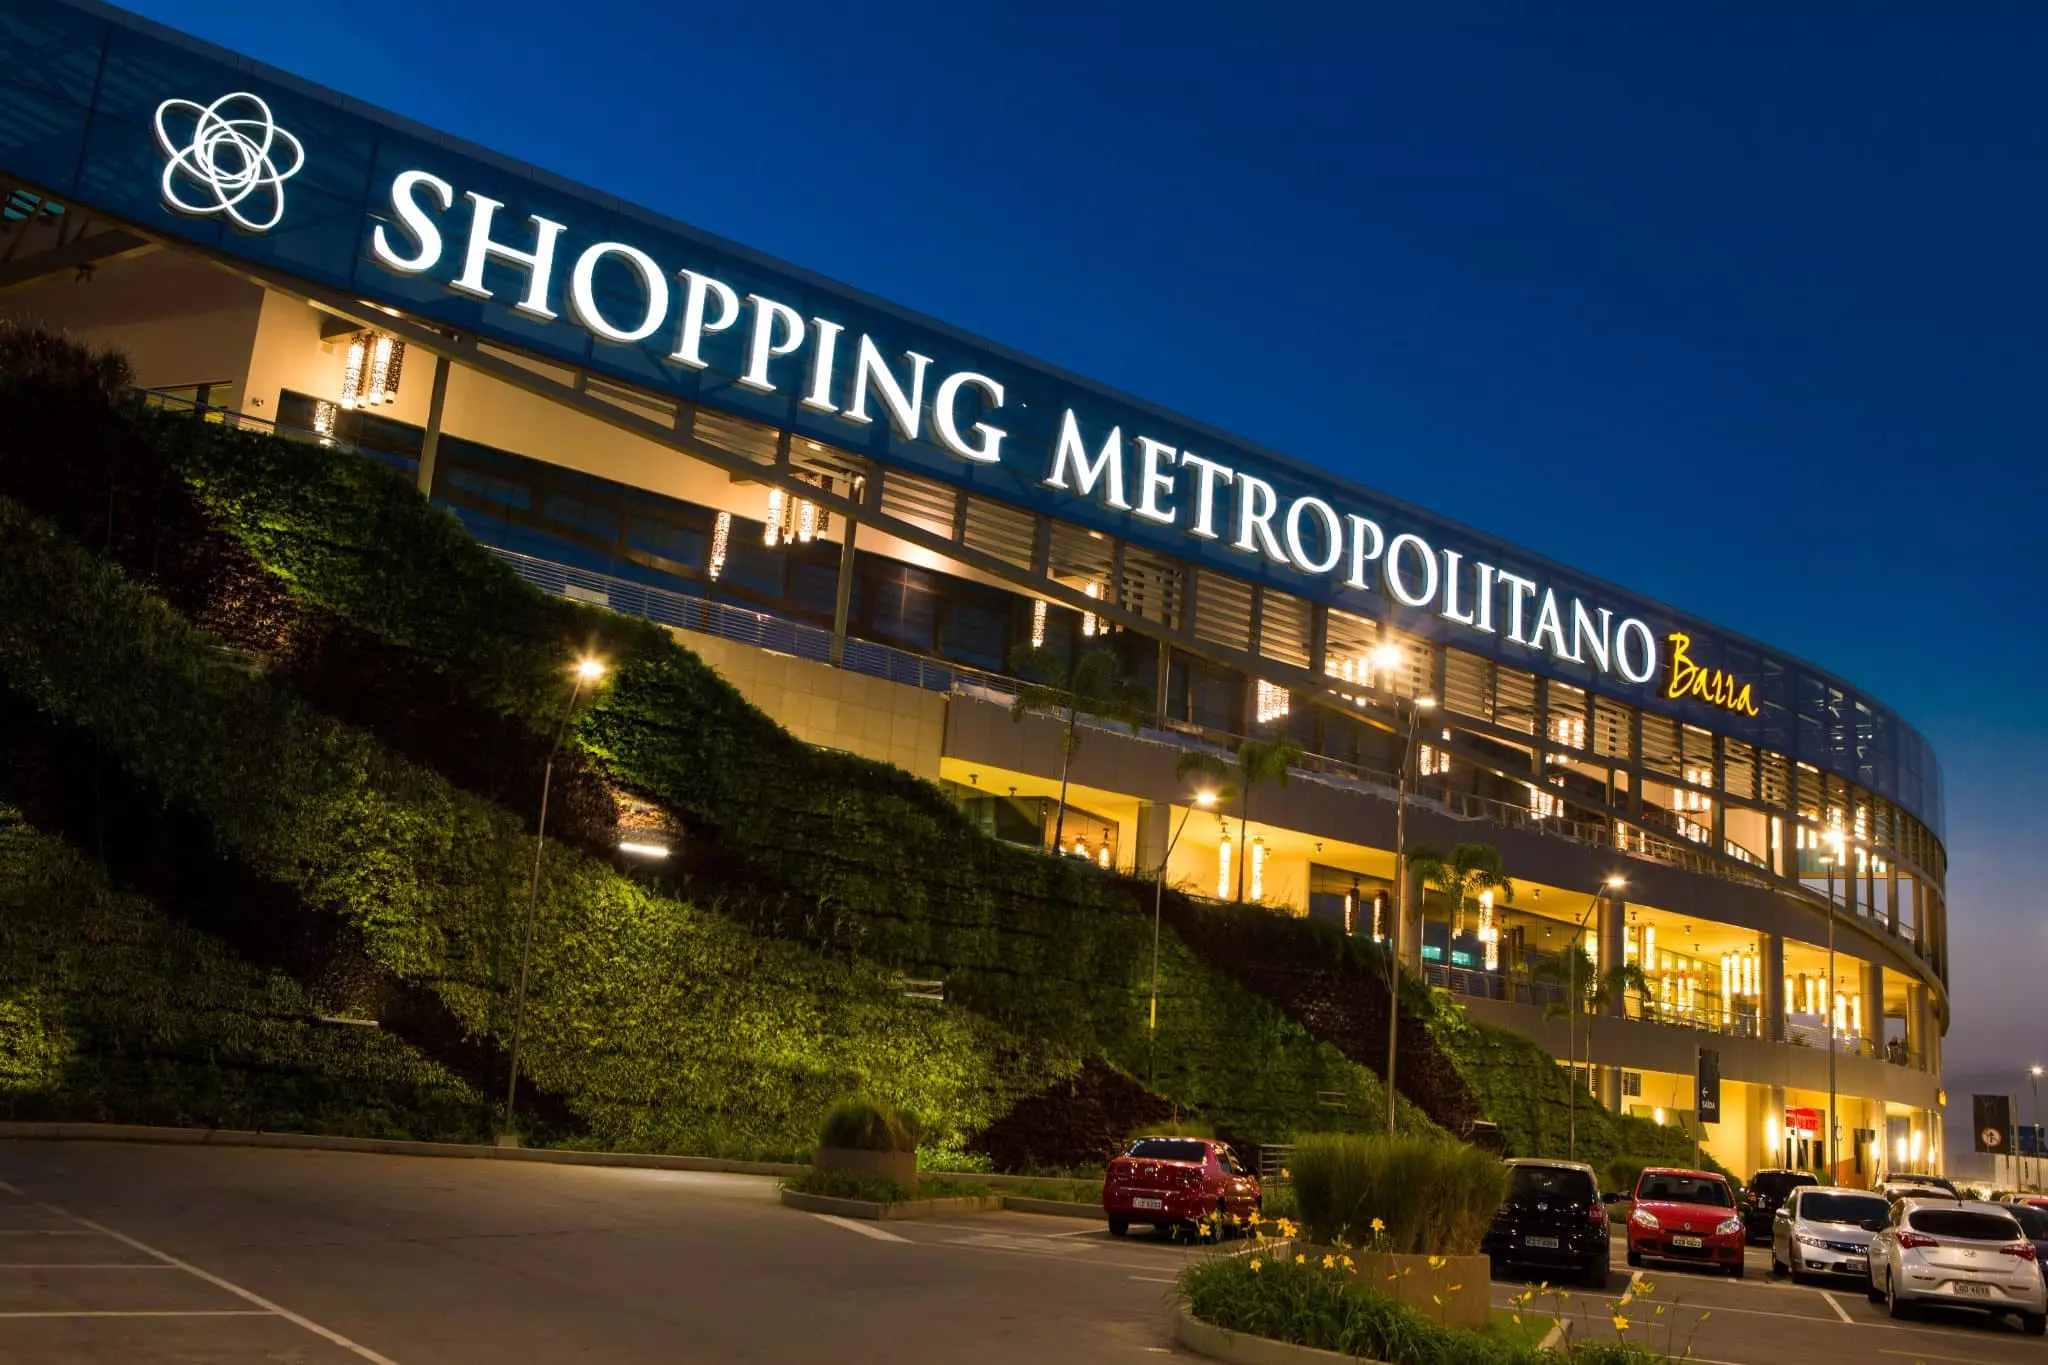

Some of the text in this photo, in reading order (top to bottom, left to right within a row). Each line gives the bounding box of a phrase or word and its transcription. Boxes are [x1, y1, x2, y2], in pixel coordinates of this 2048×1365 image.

[372, 169, 1760, 717] SHOPPING METROPOLITANO Barra
